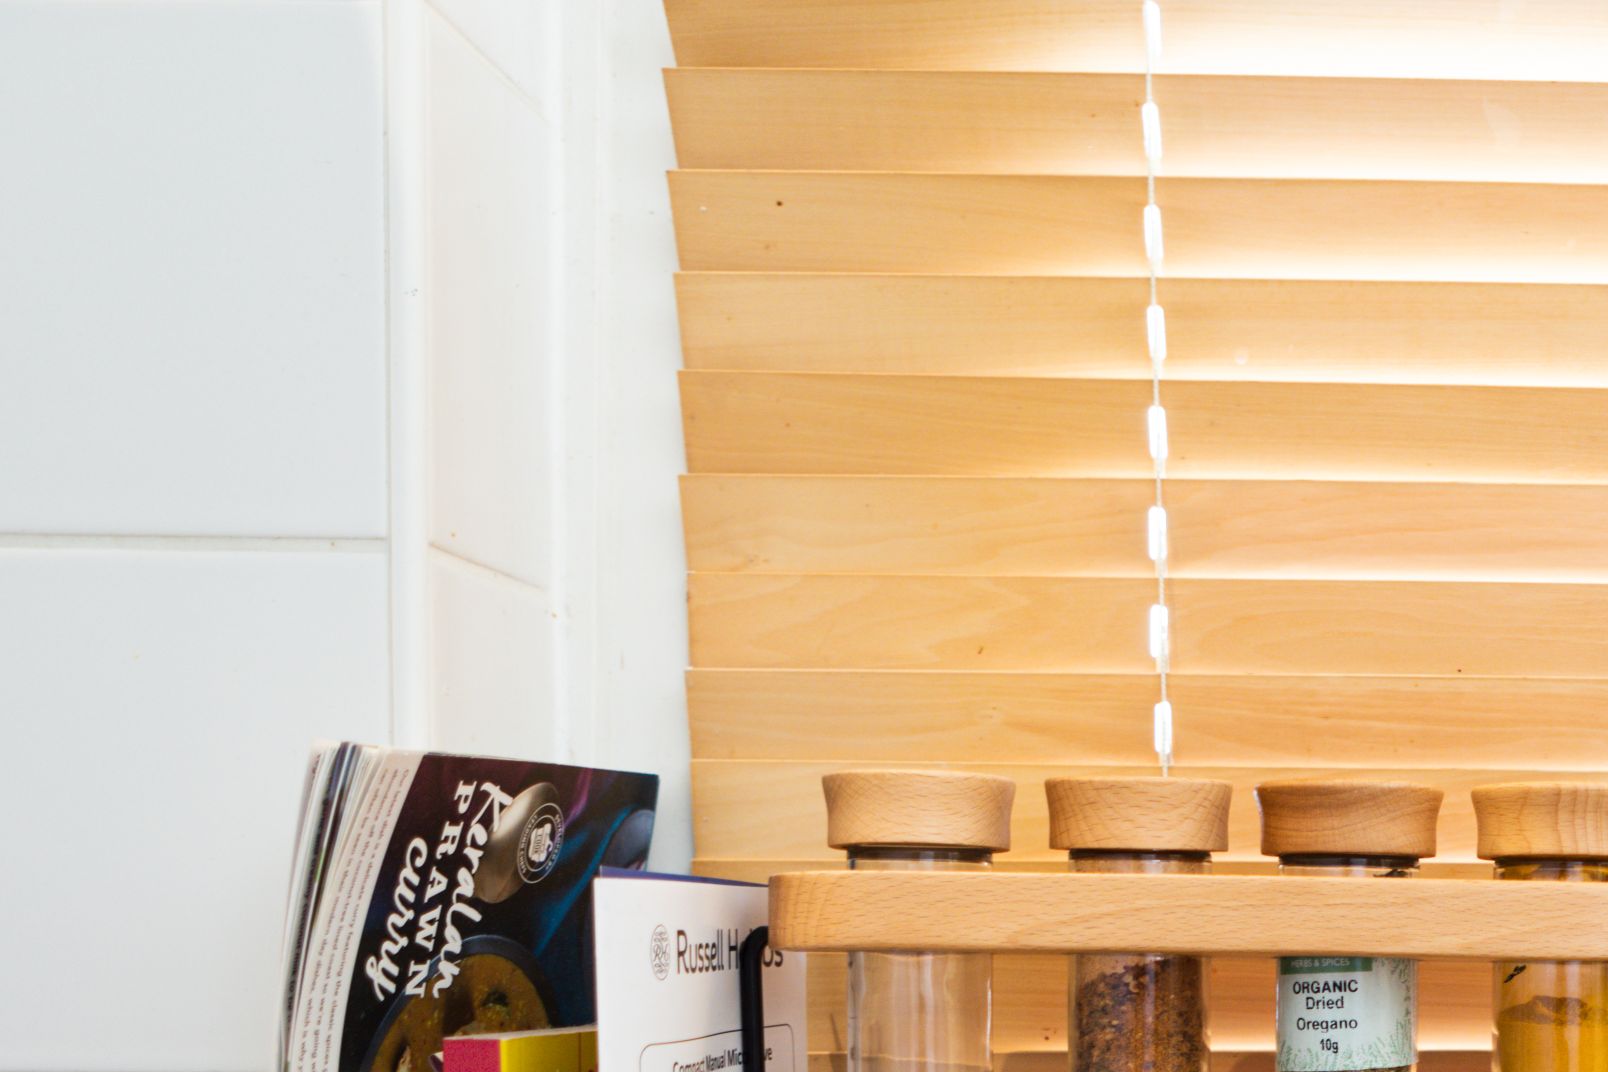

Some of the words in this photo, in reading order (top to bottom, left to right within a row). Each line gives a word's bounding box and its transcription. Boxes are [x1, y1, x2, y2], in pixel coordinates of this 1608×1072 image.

[405, 781, 478, 998] PRAWN
[433, 781, 513, 998] Keralan
[366, 837, 428, 1001] curry
[677, 929, 725, 974] Russell
[1293, 979, 1359, 995] ORGANIC
[1306, 995, 1345, 1010] Dried
[1296, 1017, 1359, 1033] Oregano
[1320, 1039, 1339, 1054] 10g
